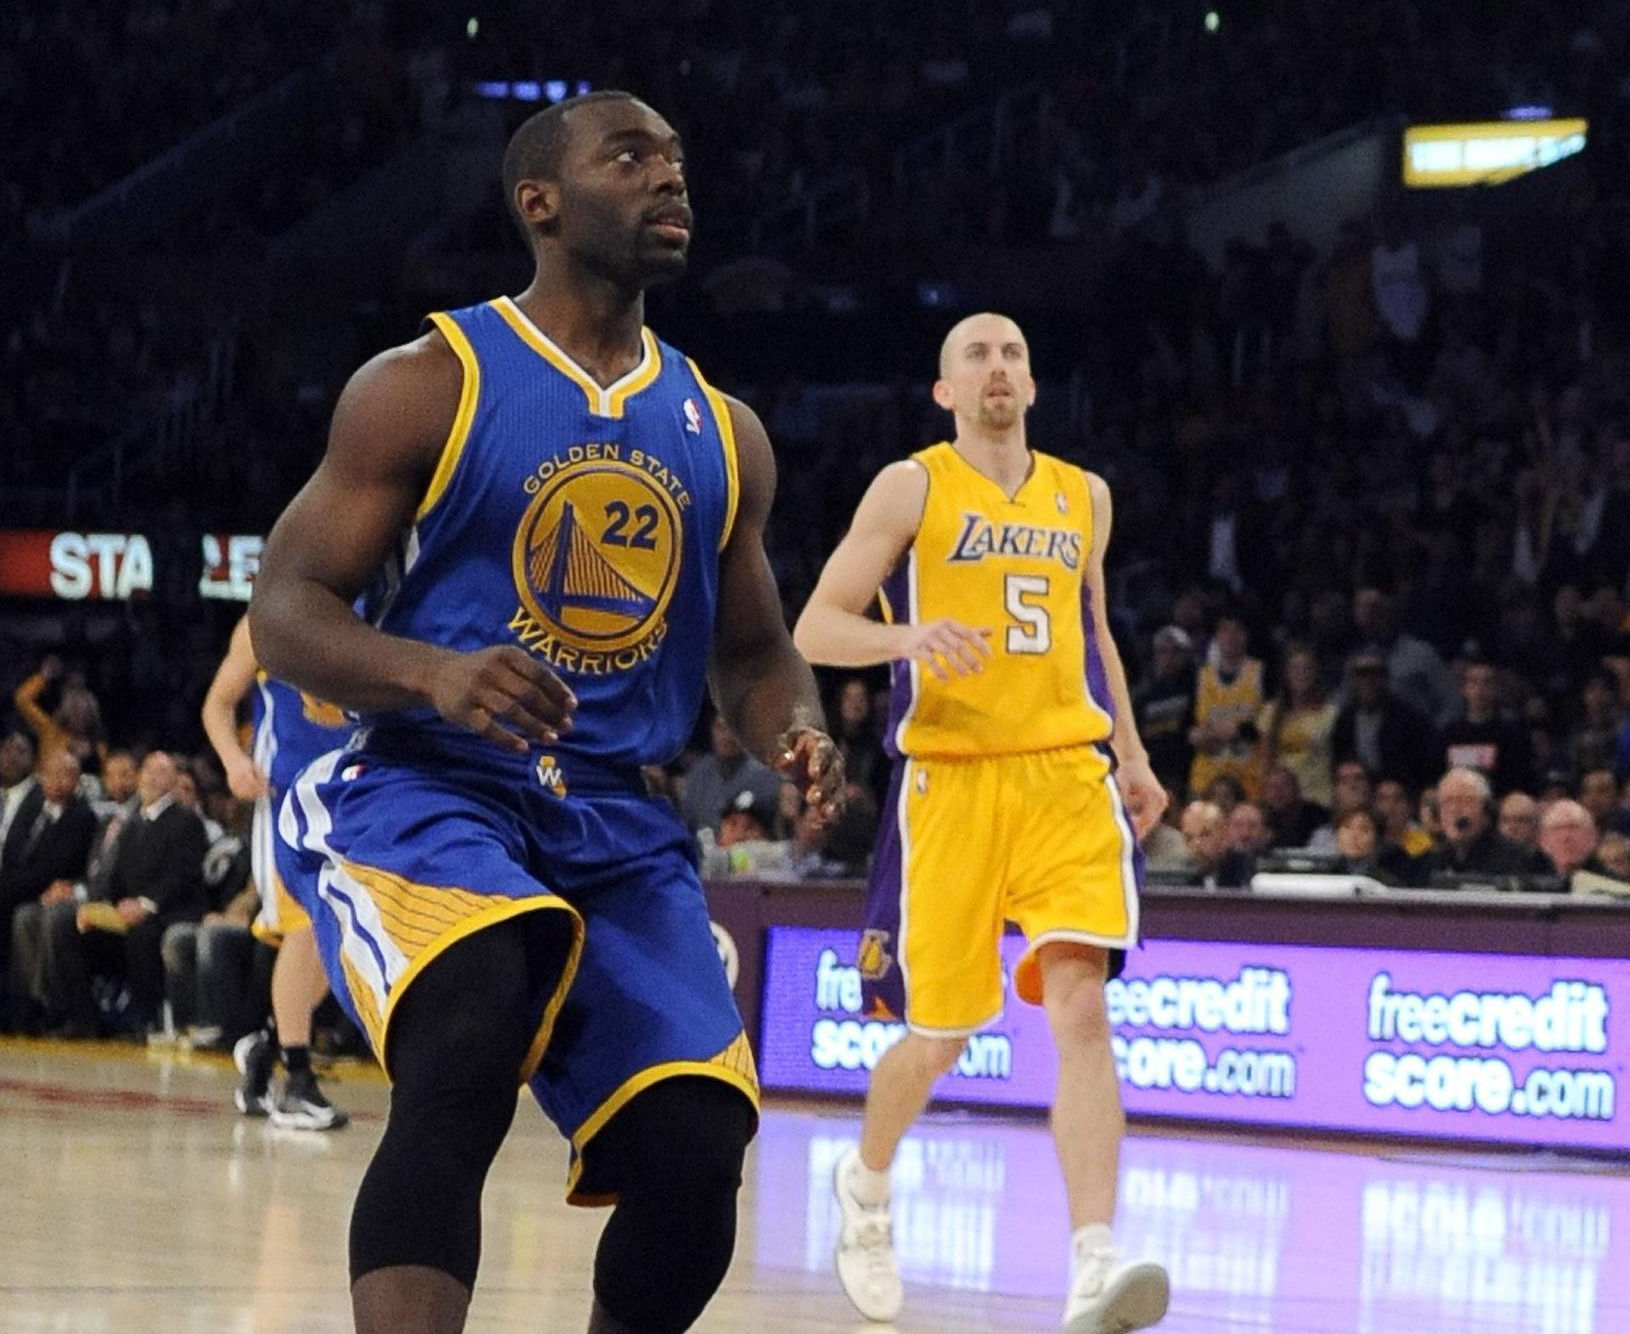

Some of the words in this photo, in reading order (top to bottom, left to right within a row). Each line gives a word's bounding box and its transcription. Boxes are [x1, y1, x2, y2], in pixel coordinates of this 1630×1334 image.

[522, 442, 621, 496] GOLDEN
[629, 448, 692, 513] STATE
[601, 499, 660, 552] 22
[946, 510, 1082, 571] LAKERS
[507, 606, 668, 676] WARRIORS
[1003, 572, 1052, 656] 5
[1104, 965, 1292, 1036] eecredit
[1367, 969, 1609, 1055] freecredit
[1111, 1033, 1297, 1099] core.com
[1363, 1049, 1616, 1121] score.com
